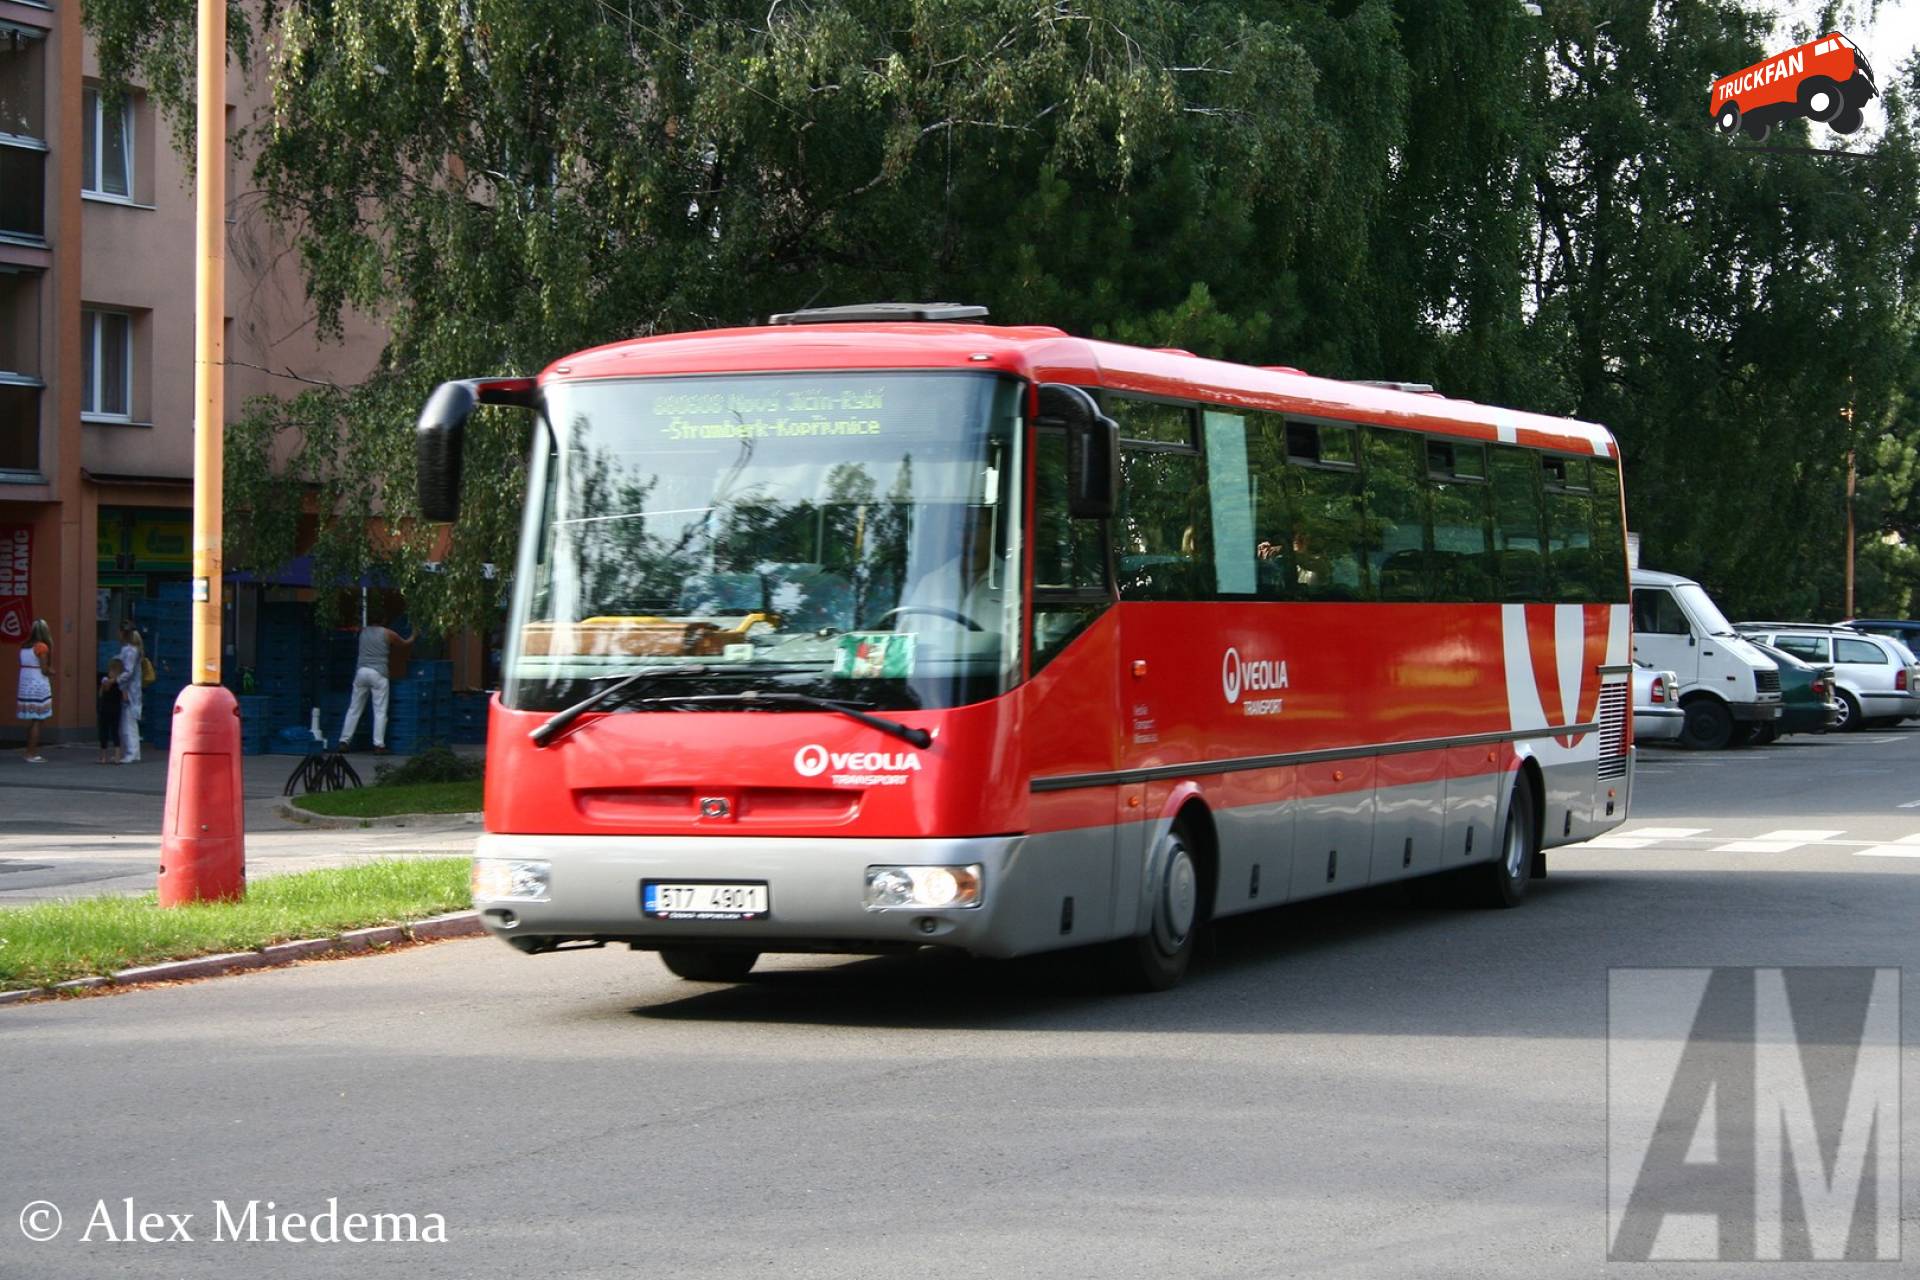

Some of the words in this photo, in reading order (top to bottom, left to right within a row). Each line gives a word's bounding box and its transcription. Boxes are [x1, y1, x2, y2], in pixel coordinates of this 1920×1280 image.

[14, 529, 29, 595] BLANC
[1241, 660, 1289, 691] VEOLIA
[1243, 699, 1283, 716] TRANSPORT
[831, 752, 922, 771] VEOLIA
[832, 774, 908, 785] TRANSPORT
